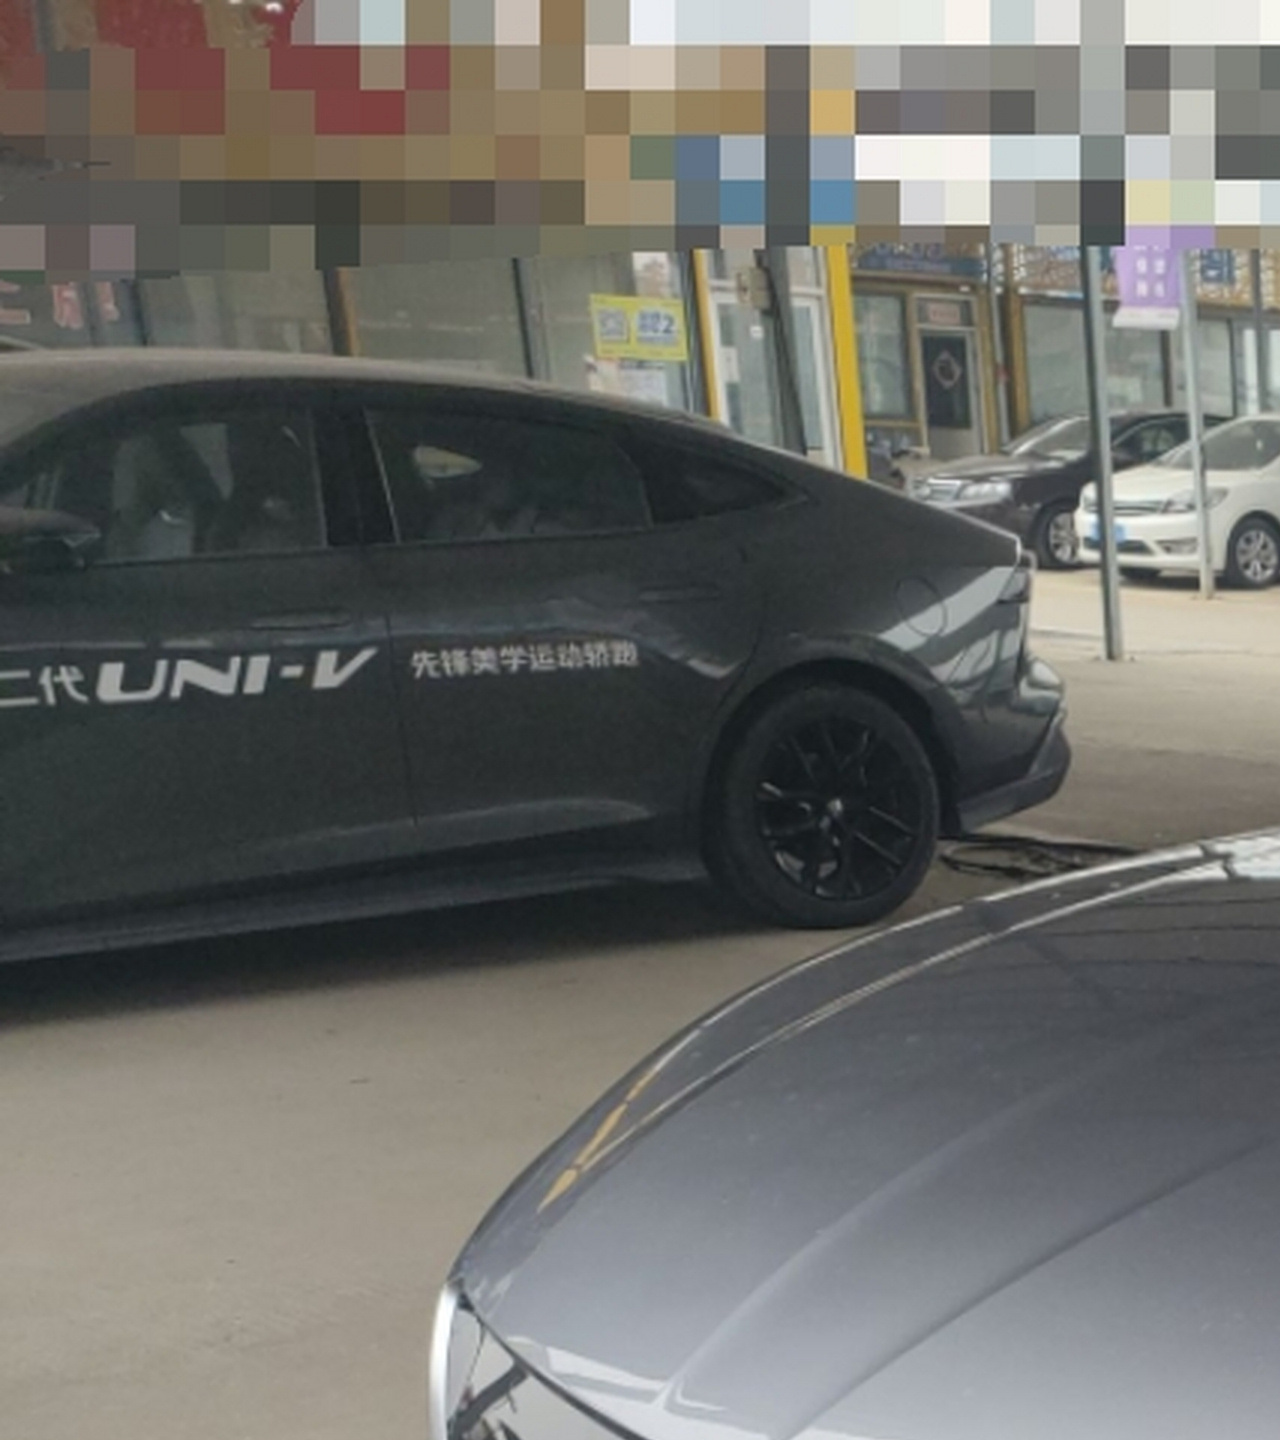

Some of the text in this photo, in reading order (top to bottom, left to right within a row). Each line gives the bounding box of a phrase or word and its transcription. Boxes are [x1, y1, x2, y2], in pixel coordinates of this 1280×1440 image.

[410, 640, 640, 680] 先锋美学运动轿跑
